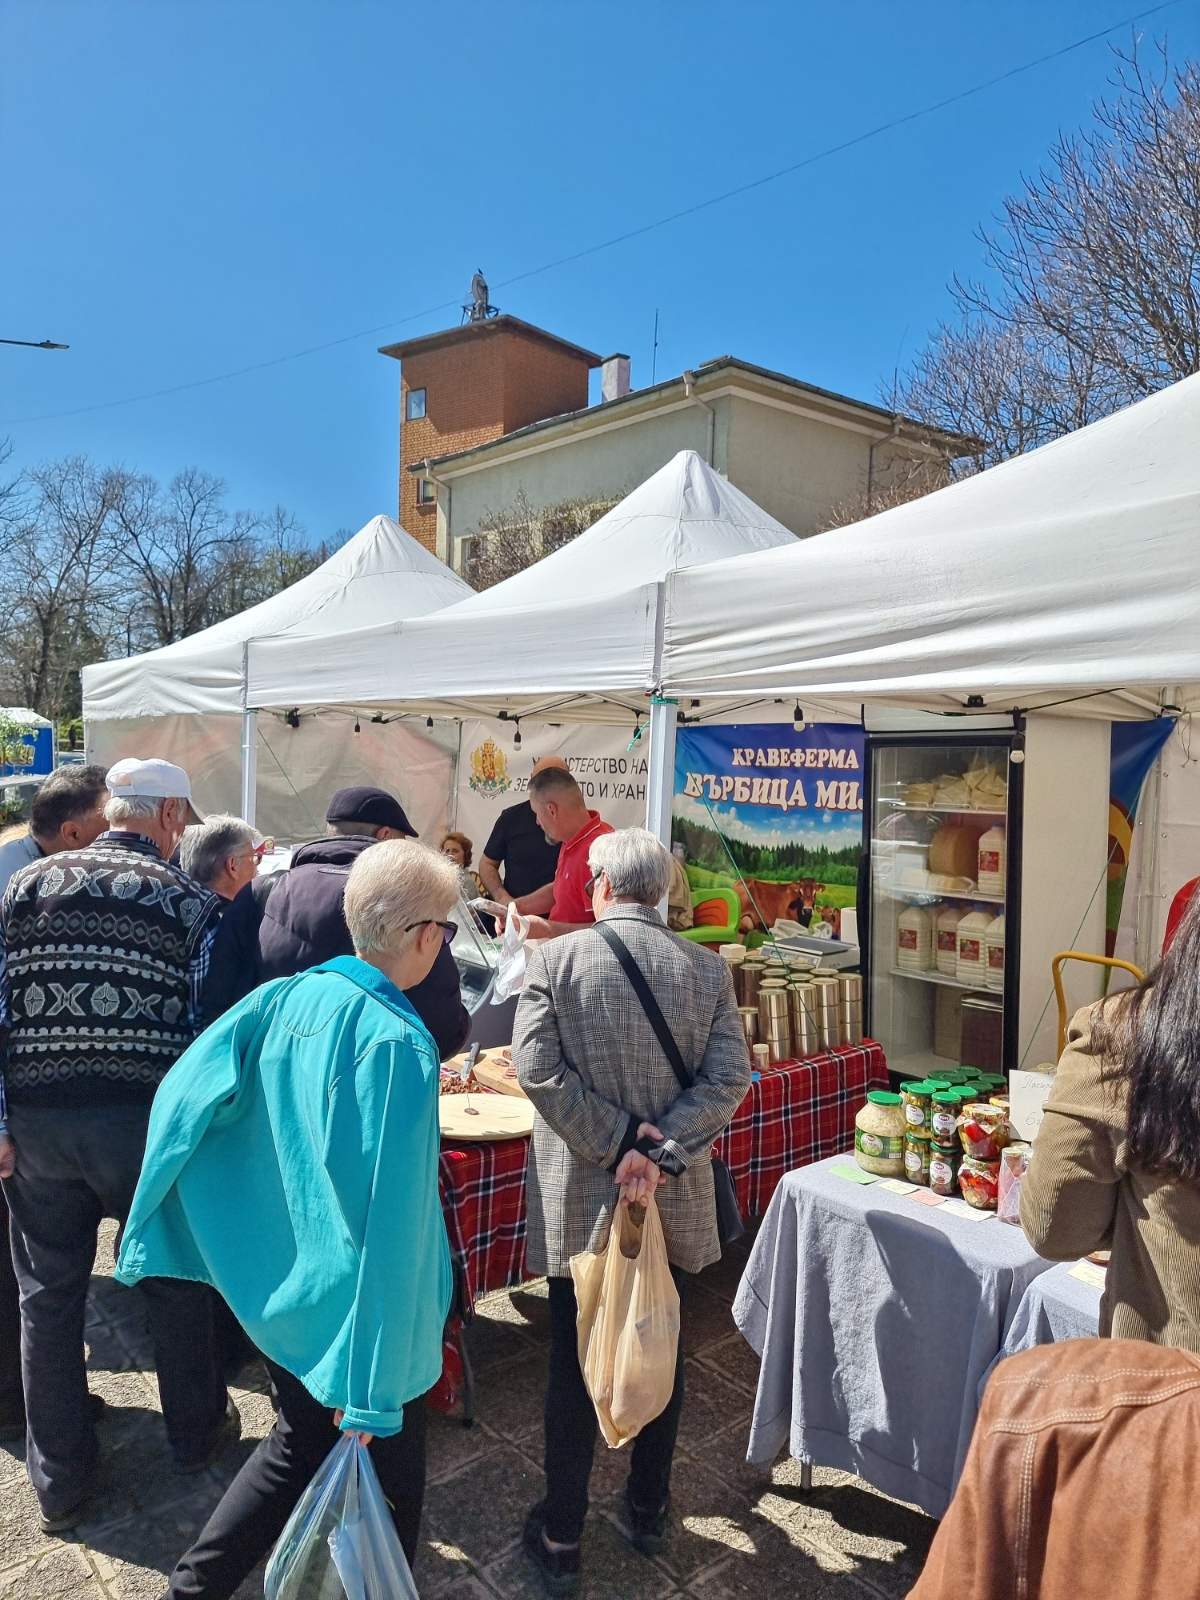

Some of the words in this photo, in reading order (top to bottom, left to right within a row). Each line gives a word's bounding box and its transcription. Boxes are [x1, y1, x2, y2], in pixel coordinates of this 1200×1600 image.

[532, 756, 627, 775] СТЕРСТВО
[630, 757, 648, 776] НА
[732, 748, 859, 769] КРАВЕФЕРМА
[599, 781, 608, 799] И
[611, 783, 646, 801] ХРАН
[684, 771, 807, 811] ВЪРБИЦА
[815, 780, 863, 810] МИ
